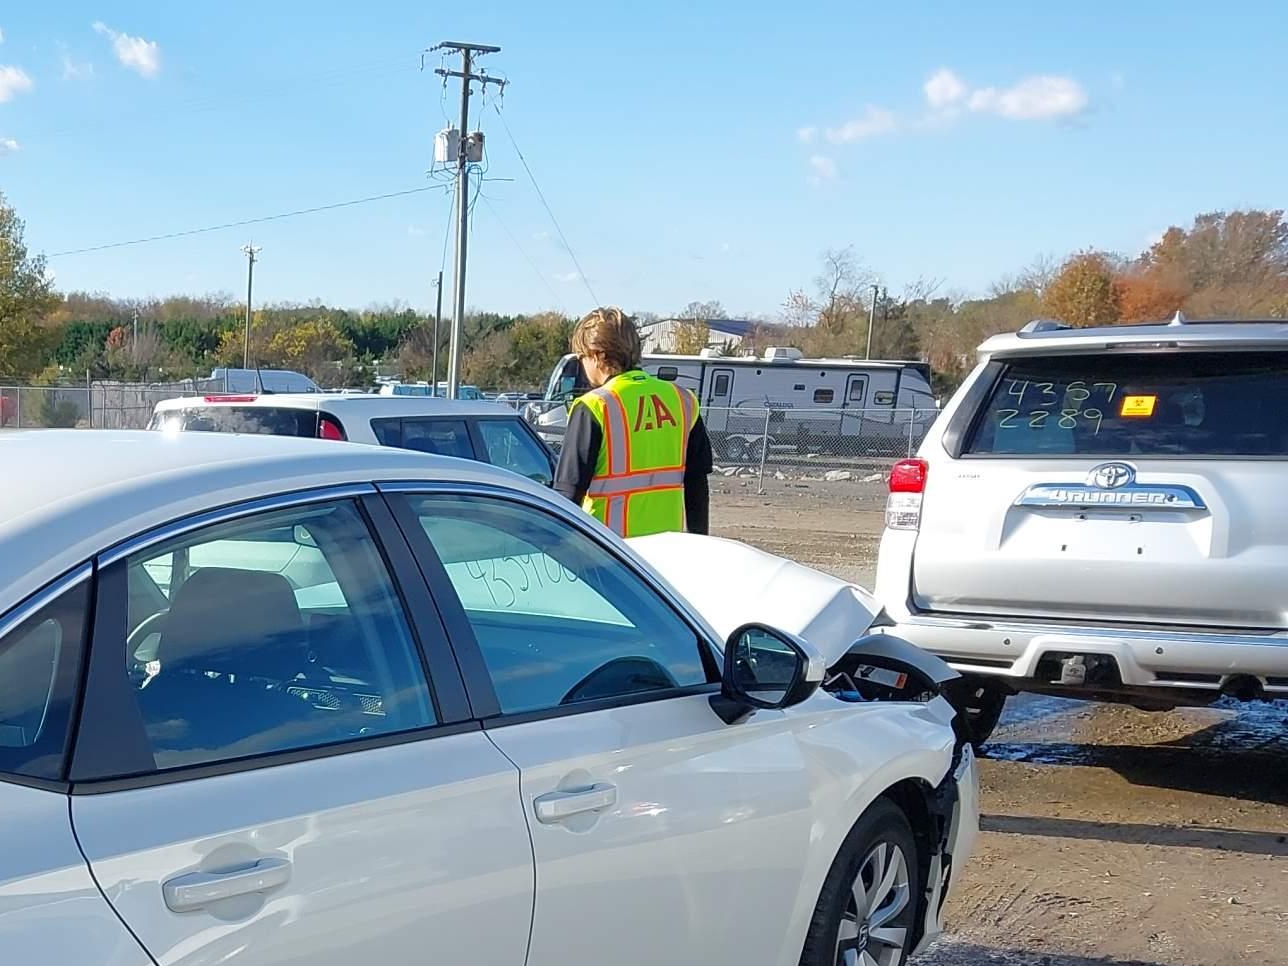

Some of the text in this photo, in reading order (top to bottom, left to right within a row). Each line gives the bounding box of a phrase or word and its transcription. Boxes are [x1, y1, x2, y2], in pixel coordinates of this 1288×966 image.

[1008, 380, 1117, 406] 4357
[995, 408, 1103, 436] 2289
[1048, 489, 1165, 505] 4RUNNER
